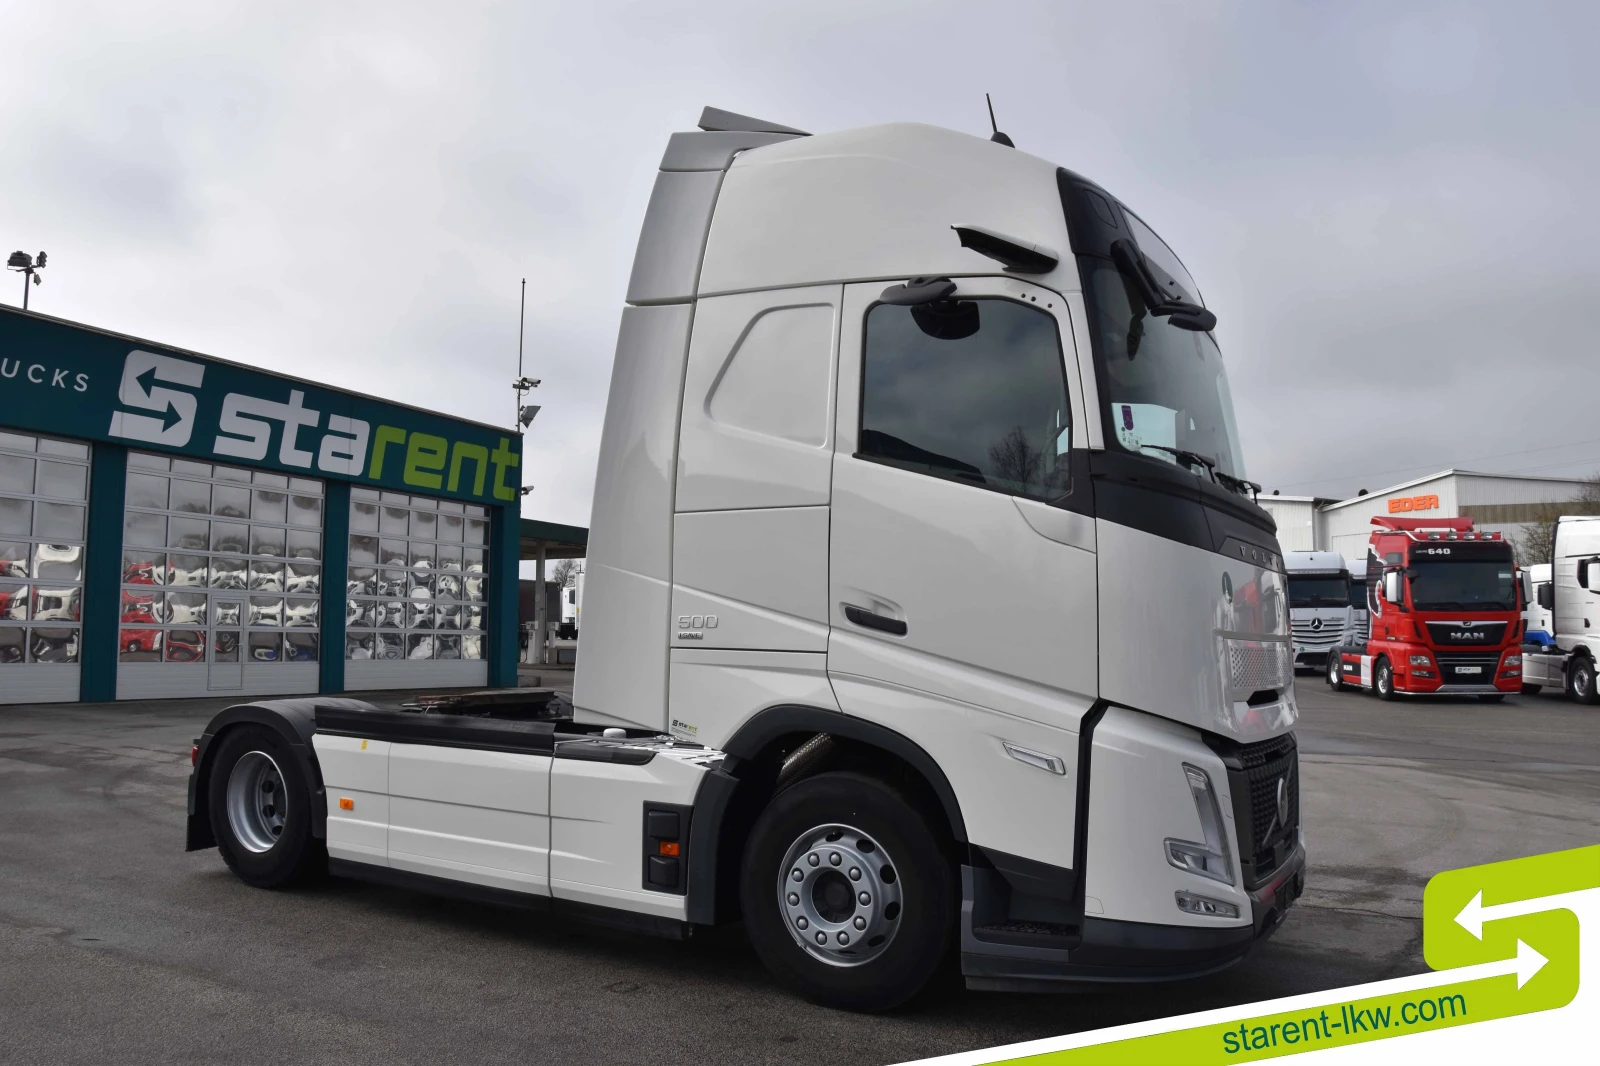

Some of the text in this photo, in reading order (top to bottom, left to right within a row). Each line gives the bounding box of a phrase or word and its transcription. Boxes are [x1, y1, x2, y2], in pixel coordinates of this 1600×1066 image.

[213, 389, 520, 502] starent
[1388, 494, 1439, 513] EDER
[678, 615, 719, 629] 500
[1450, 632, 1485, 640] MAN
